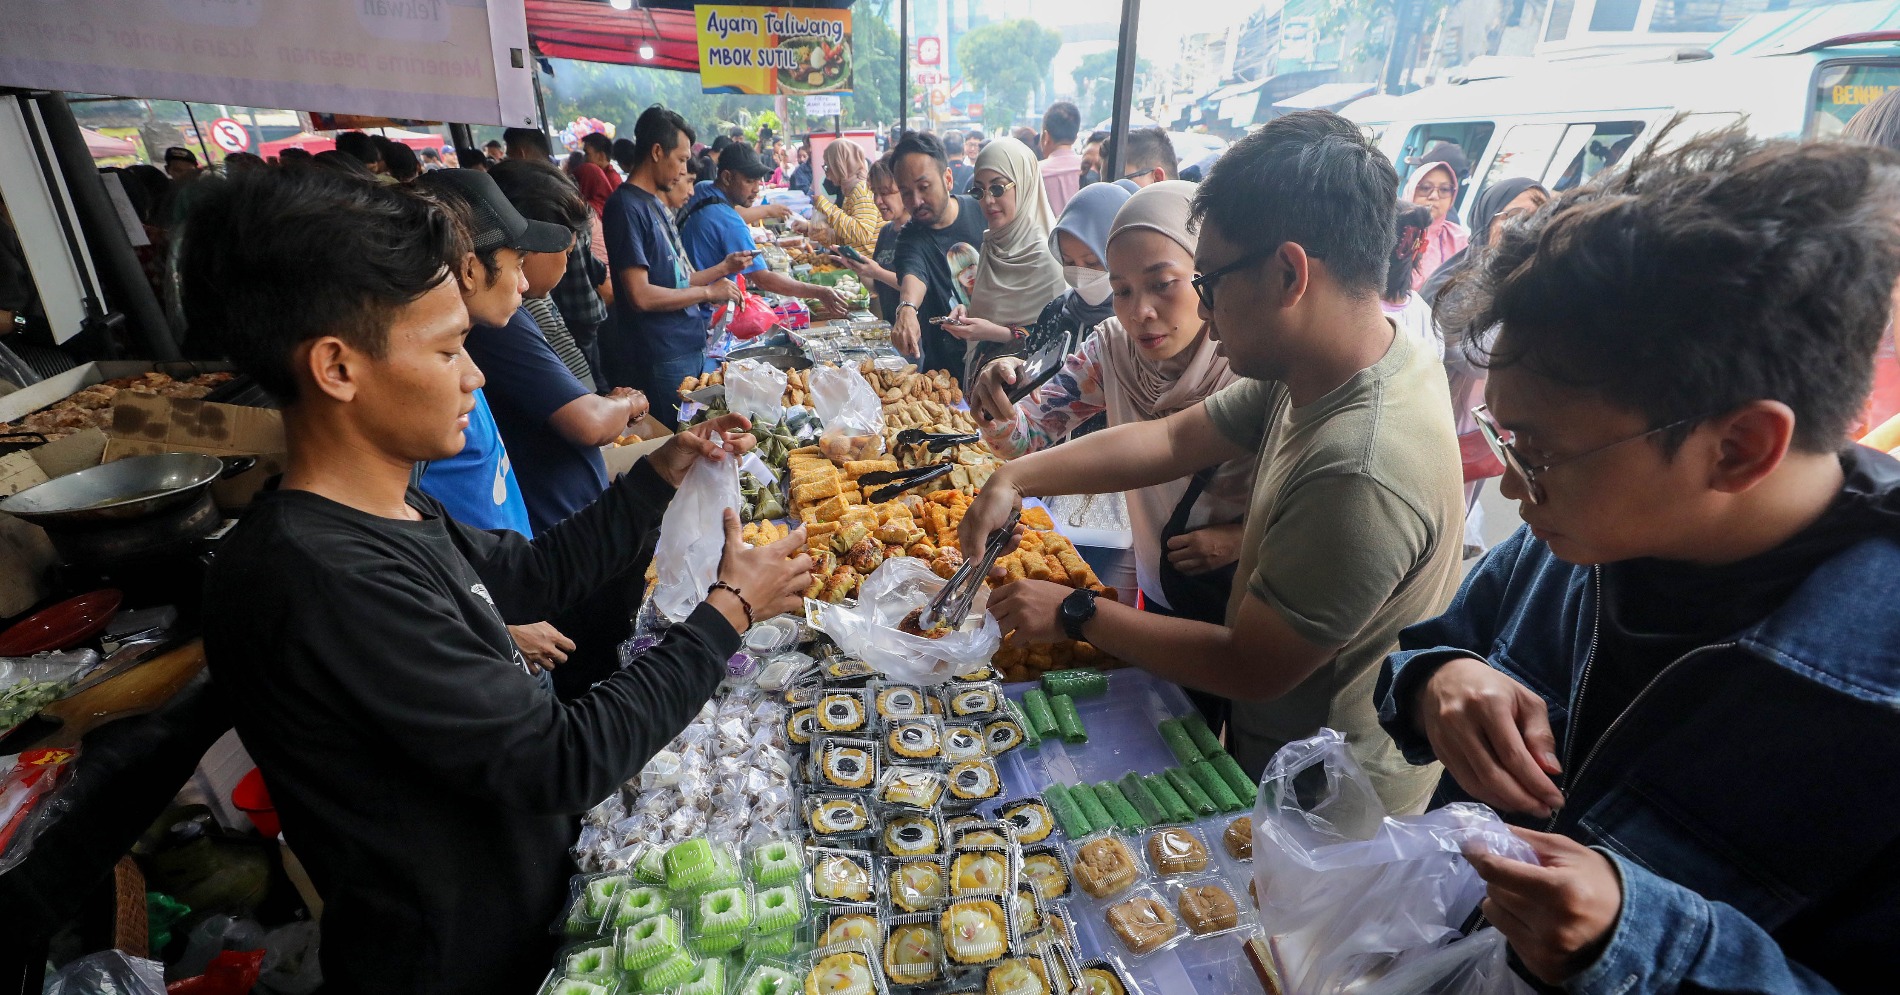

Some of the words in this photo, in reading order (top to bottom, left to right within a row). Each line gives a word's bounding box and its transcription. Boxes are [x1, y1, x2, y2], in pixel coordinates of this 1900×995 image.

[706, 11, 758, 39] Ayam
[764, 11, 843, 42] Taliwang
[708, 47, 752, 66] MBOK
[757, 48, 797, 68] SUTIL
